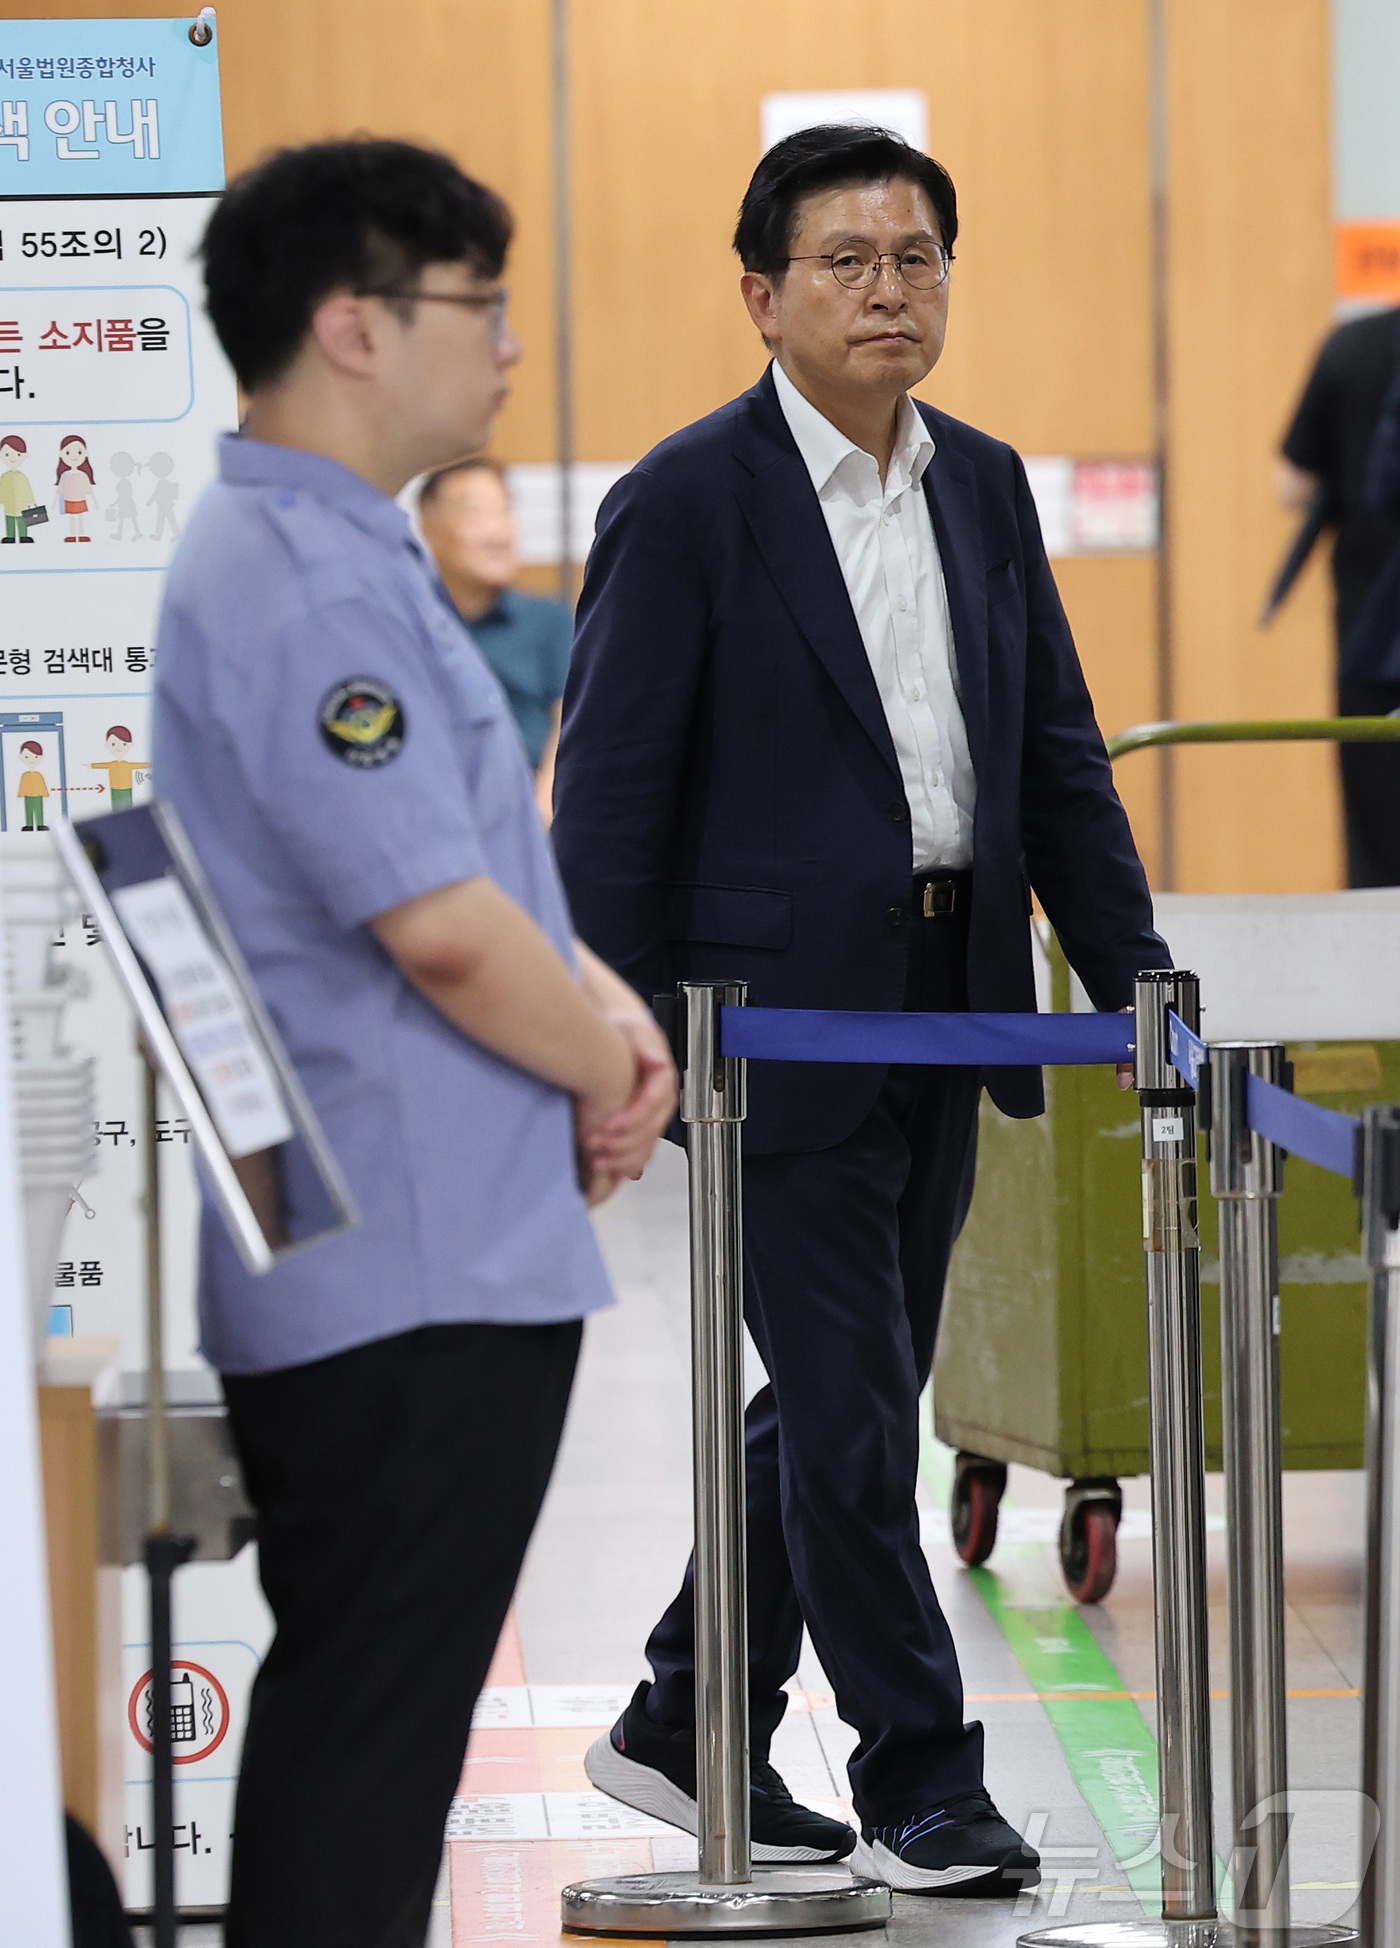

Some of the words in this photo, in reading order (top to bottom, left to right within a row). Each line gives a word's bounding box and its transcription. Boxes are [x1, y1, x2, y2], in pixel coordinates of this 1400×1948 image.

[0, 56, 156, 80] 서울법원종합청사
[44, 98, 161, 160] 안내
[21, 228, 123, 260] 55조의
[138, 226, 168, 260] 2)
[38, 317, 170, 353] 소지품을
[43, 647, 113, 674] 검색대
[124, 646, 156, 673] 통
[55, 1260, 104, 1288] 물품
